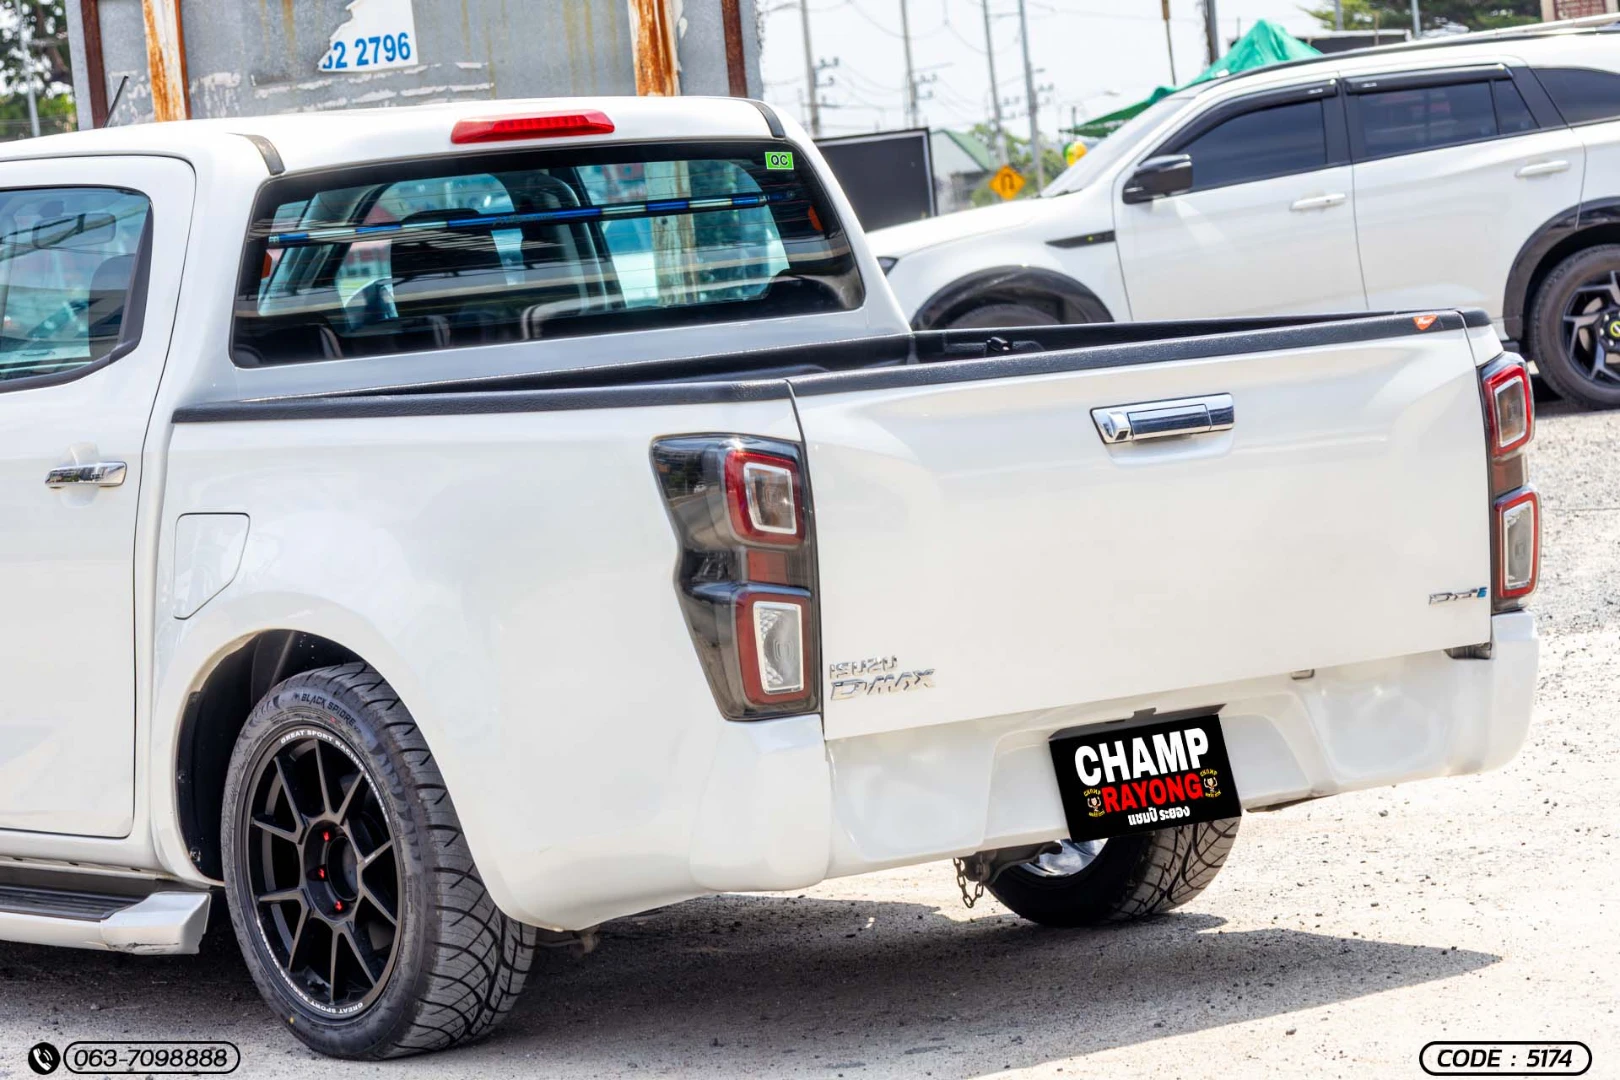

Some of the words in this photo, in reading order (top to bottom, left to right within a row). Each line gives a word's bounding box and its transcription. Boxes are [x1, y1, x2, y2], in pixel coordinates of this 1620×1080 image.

[354, 32, 411, 66] 2796
[770, 154, 789, 166] QC
[301, 693, 326, 709] BLACK
[327, 701, 357, 727] SPIDRE
[280, 730, 305, 744] GREAT
[306, 730, 333, 742] SPORT
